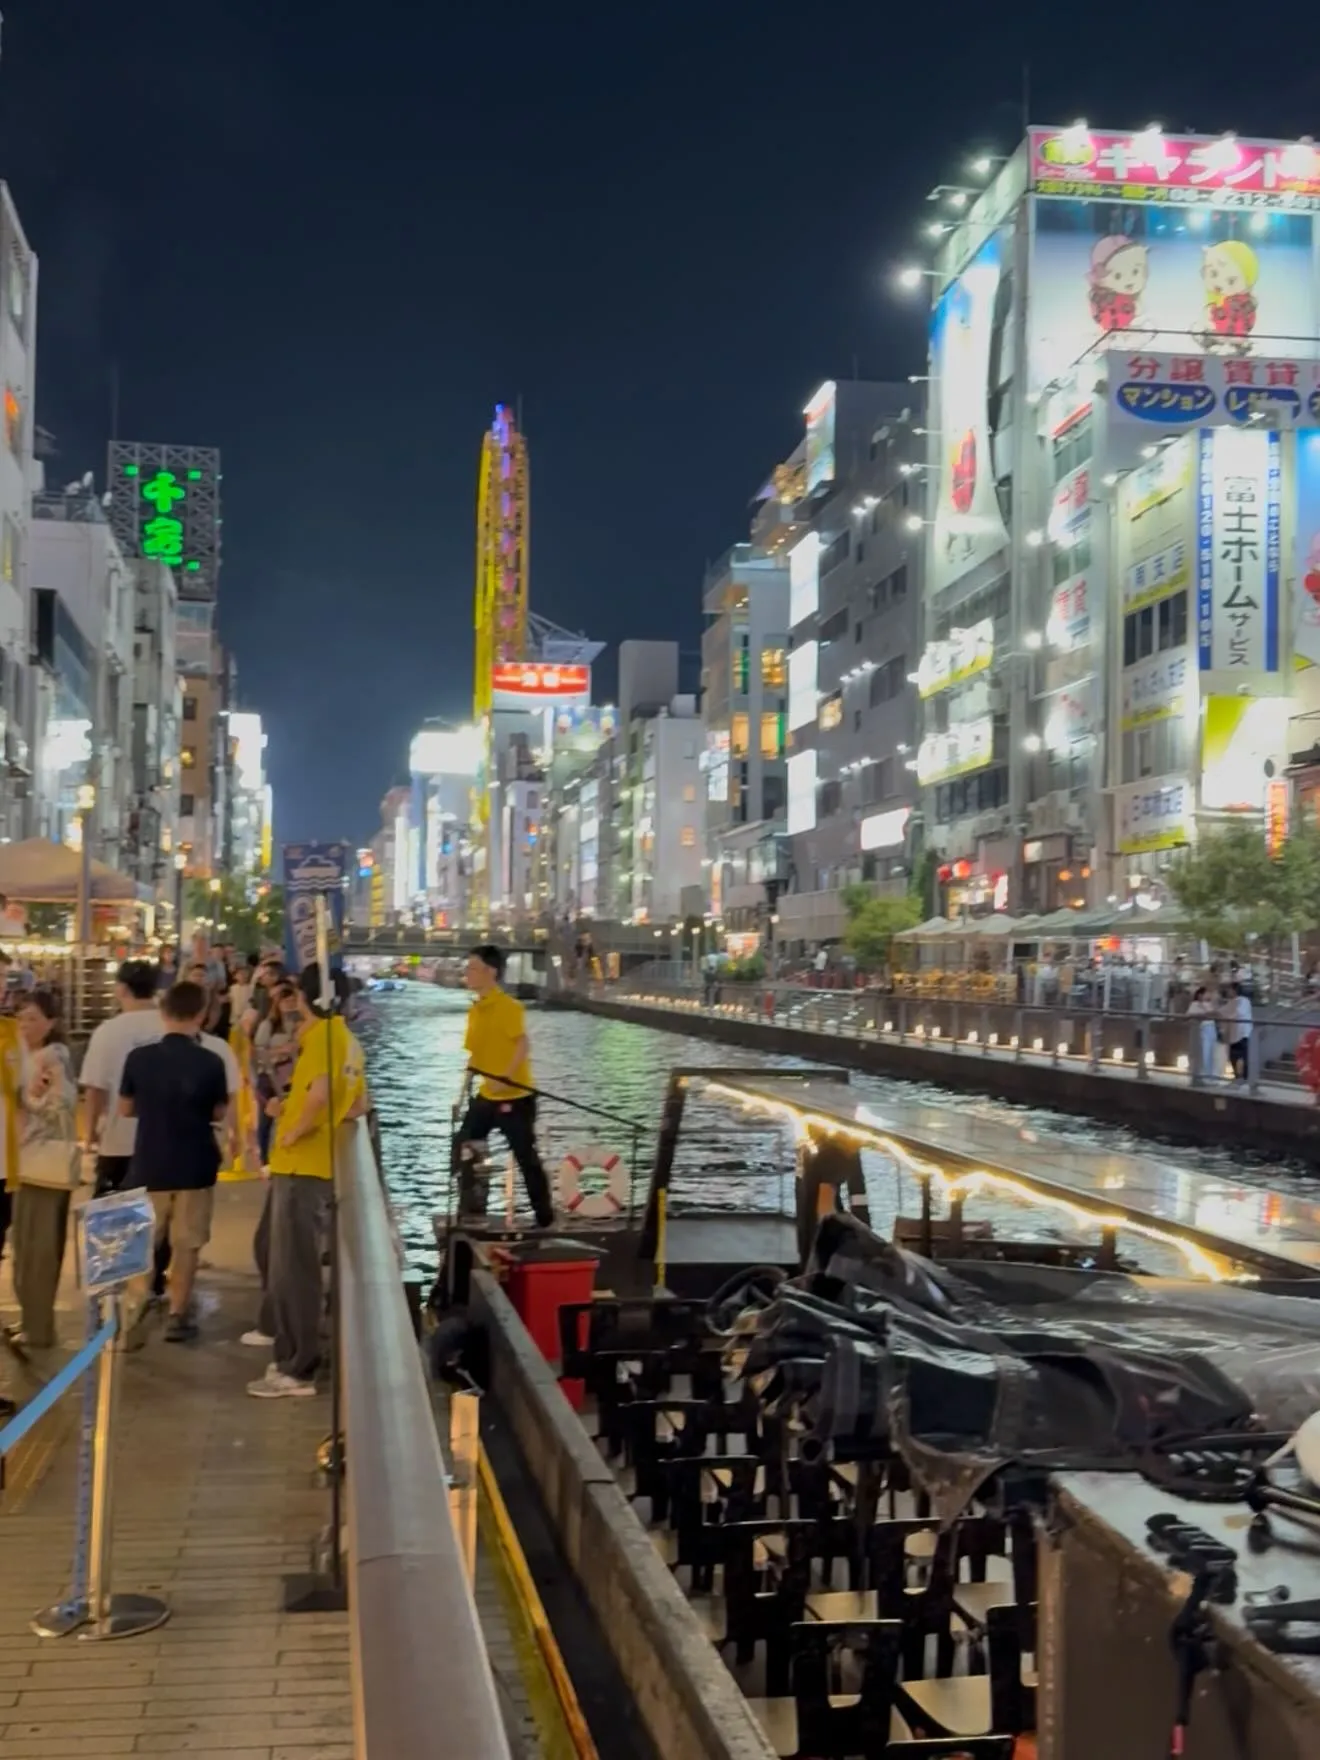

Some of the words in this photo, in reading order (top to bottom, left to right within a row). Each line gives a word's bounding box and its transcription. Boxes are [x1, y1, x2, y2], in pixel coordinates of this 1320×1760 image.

[1122, 385, 1214, 411] マンション
[1221, 476, 1259, 666] 富士ホームサービス
